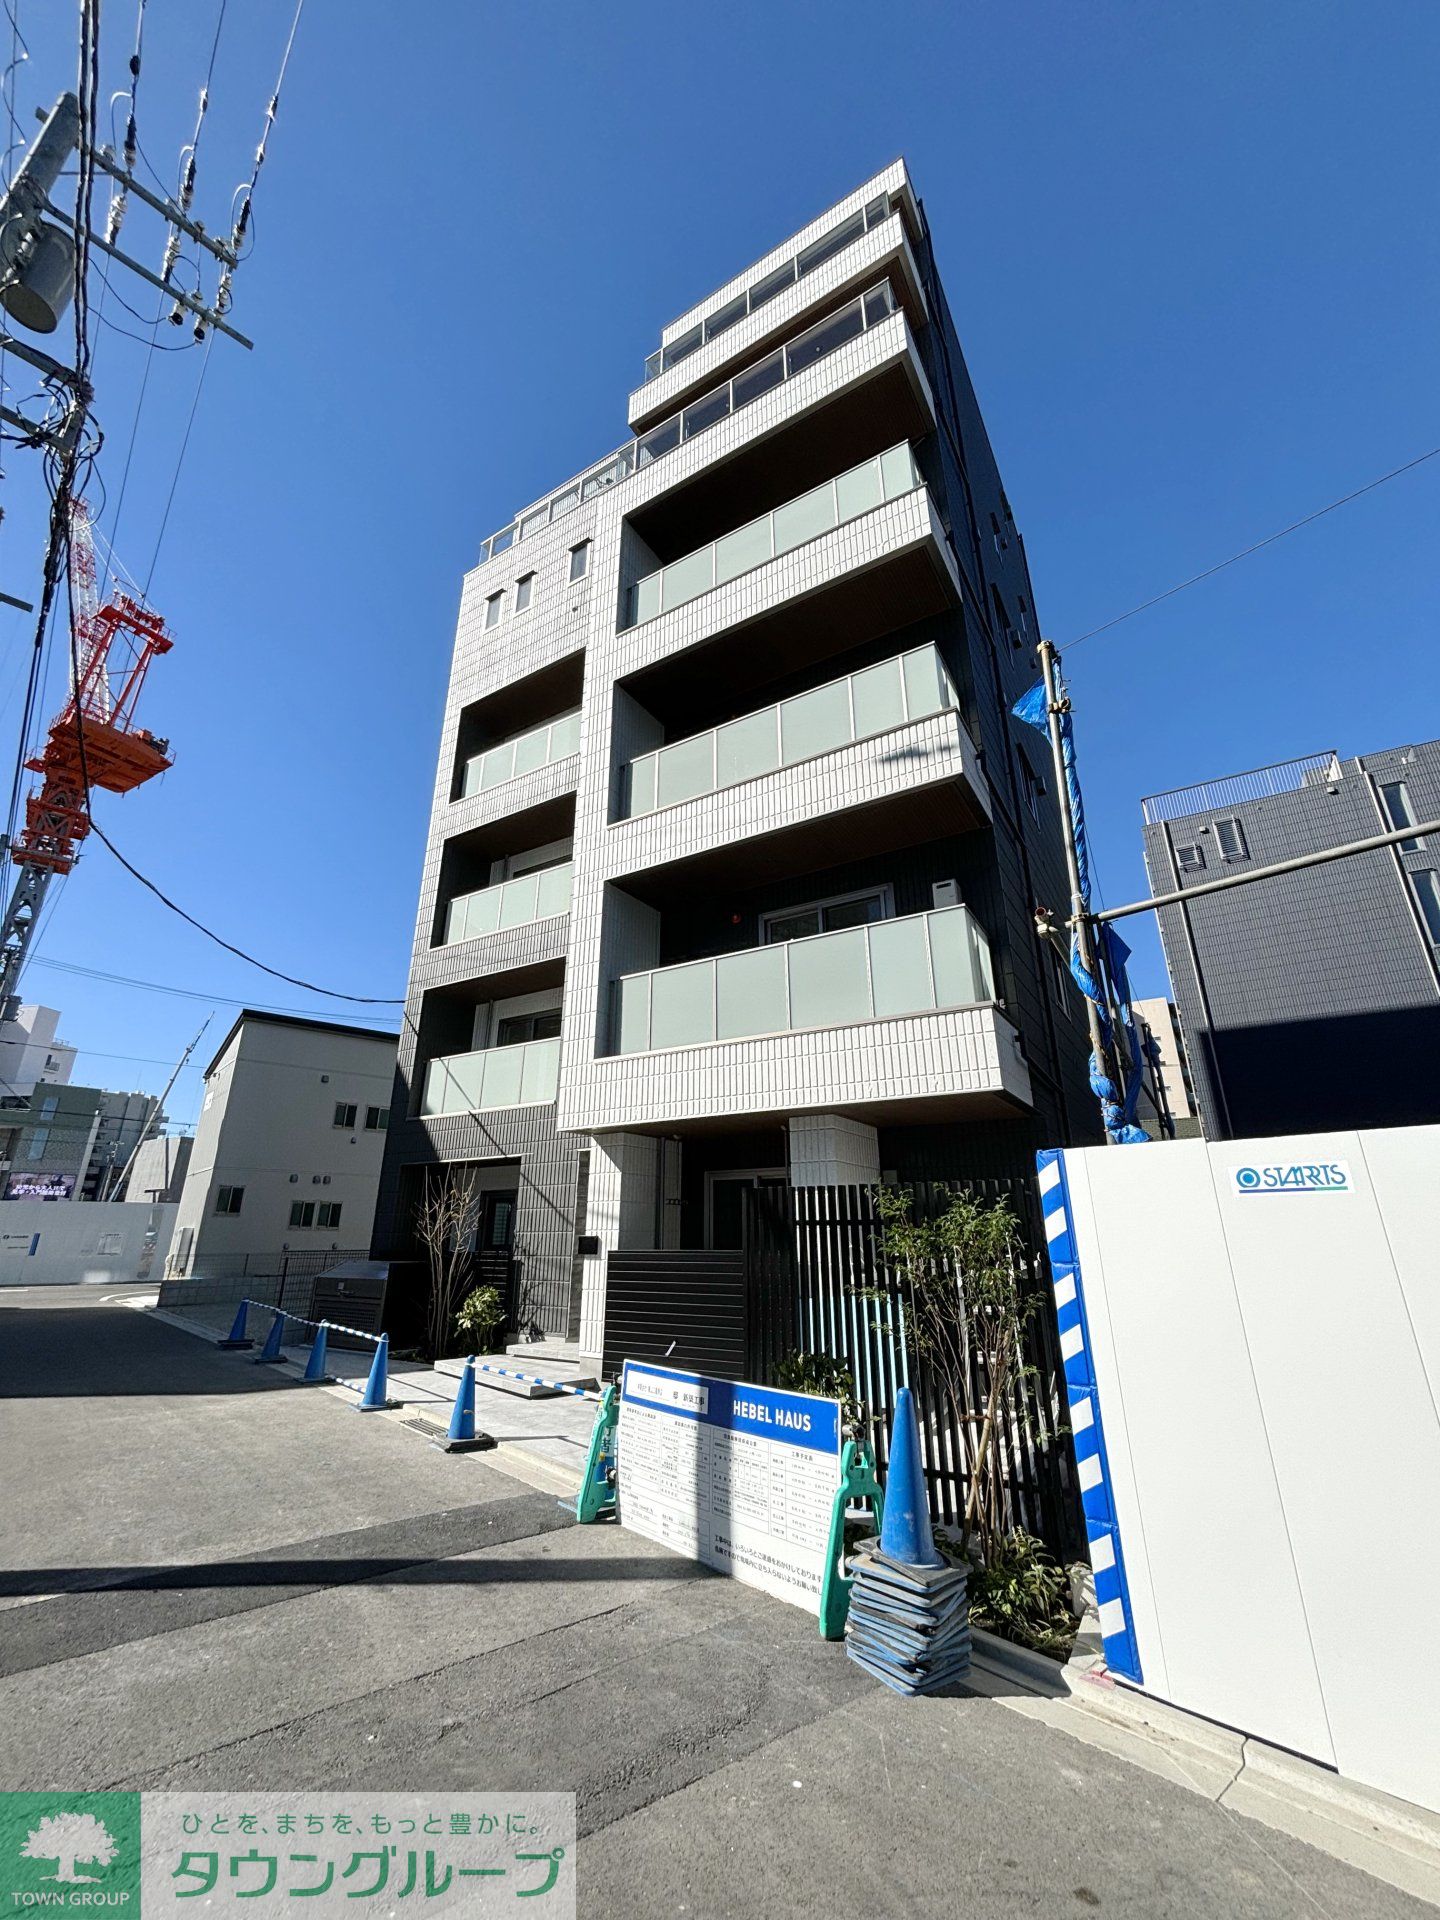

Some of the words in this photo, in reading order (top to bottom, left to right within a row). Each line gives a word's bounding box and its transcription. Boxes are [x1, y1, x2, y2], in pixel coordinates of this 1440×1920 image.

[1263, 1164, 1347, 1187] STARTS
[733, 1399, 773, 1424] HEBEL
[775, 1408, 811, 1432] HAUS
